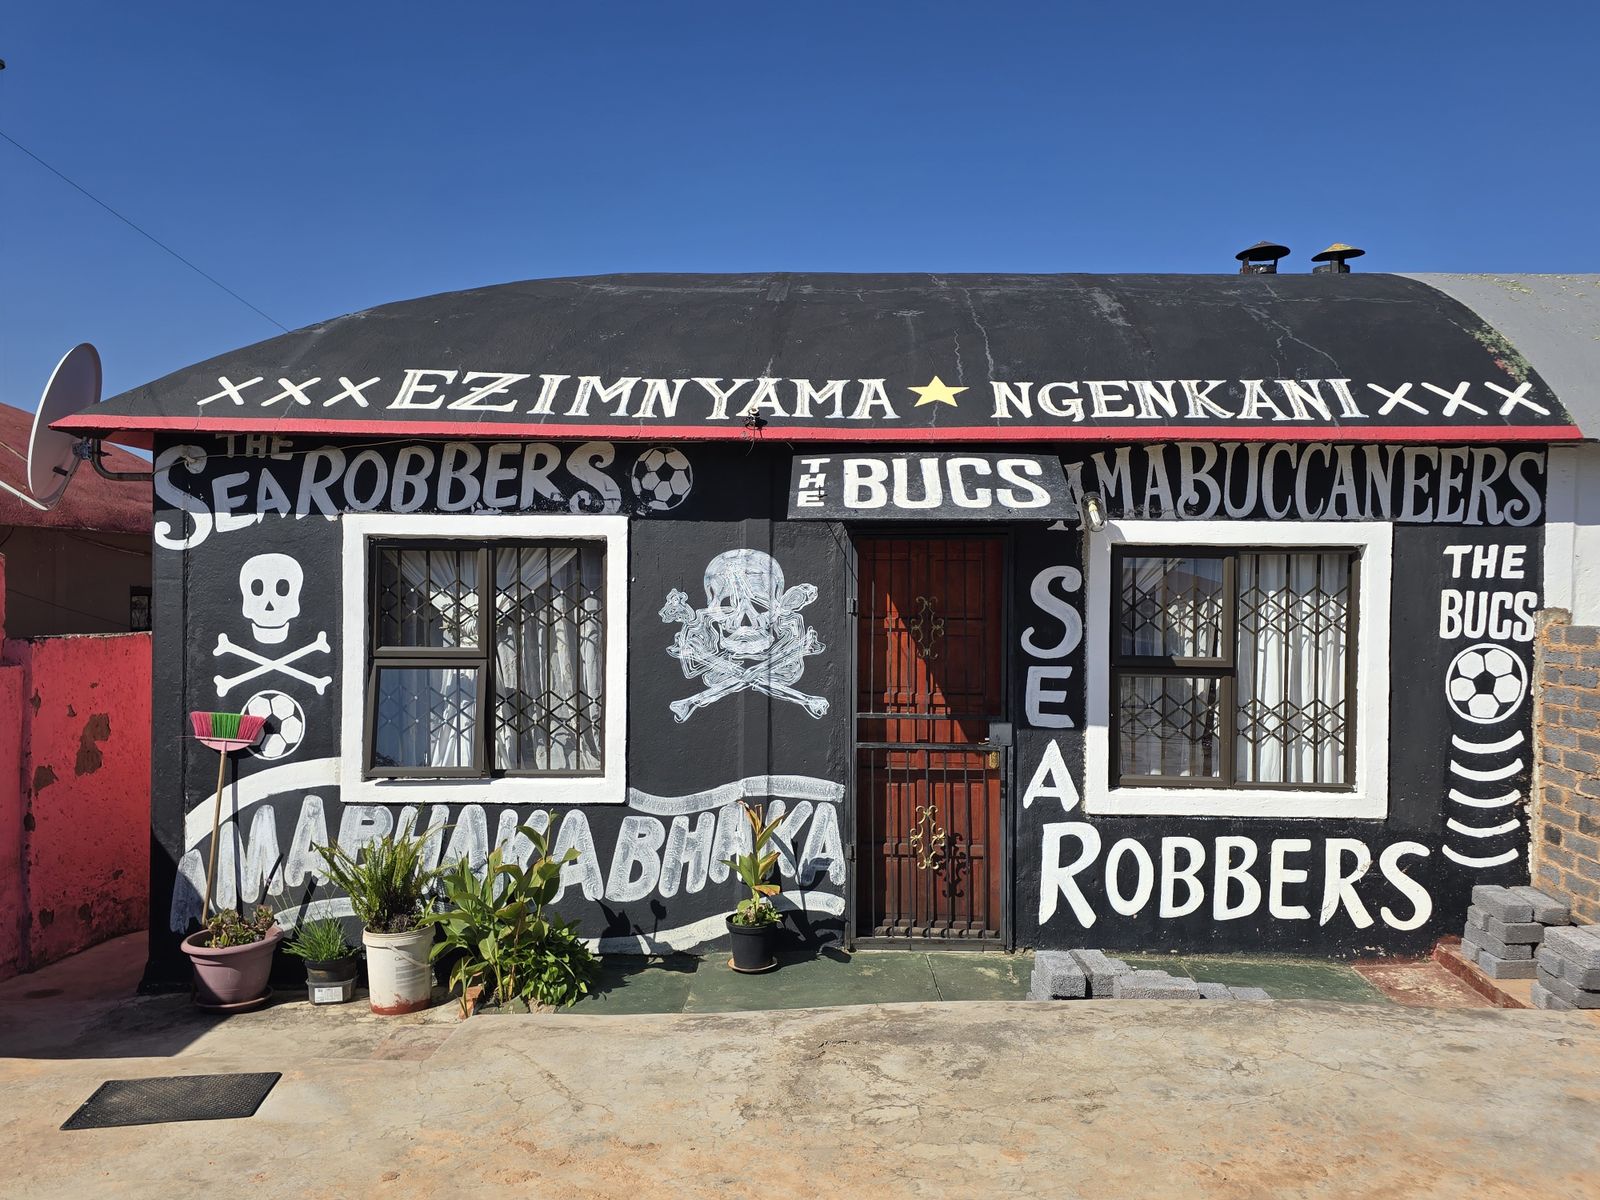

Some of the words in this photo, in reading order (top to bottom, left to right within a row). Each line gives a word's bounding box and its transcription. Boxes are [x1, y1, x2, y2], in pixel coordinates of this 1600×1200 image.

[386, 368, 900, 420] EZIMNYAMA
[990, 377, 1369, 423] NGENKANI
[215, 433, 294, 461] THE
[797, 458, 831, 507] THE
[843, 458, 1052, 509] BUCS
[1443, 544, 1527, 579] THE
[1440, 589, 1538, 642] BUCS
[1038, 821, 1433, 932] ROBBERS
